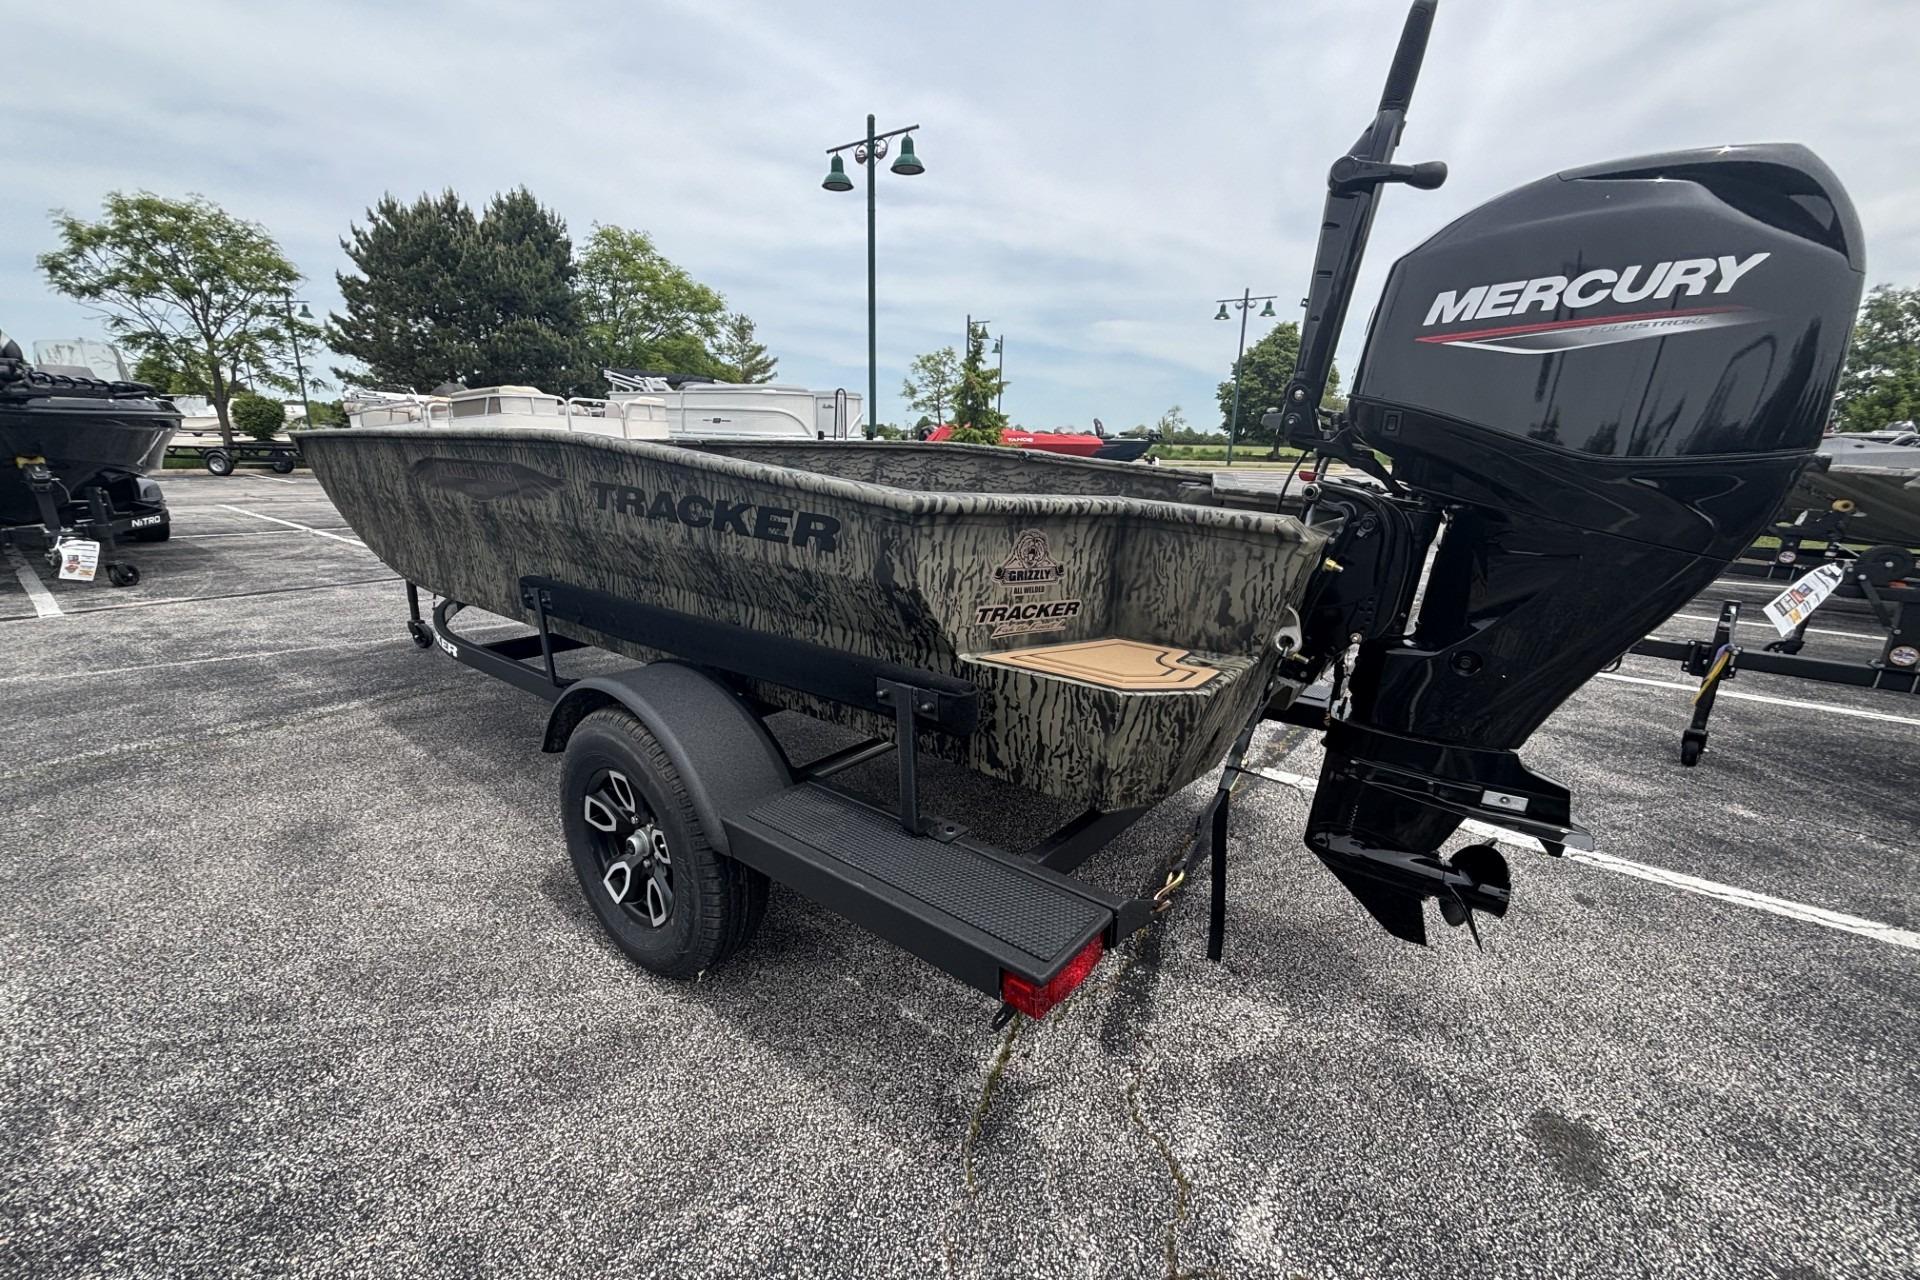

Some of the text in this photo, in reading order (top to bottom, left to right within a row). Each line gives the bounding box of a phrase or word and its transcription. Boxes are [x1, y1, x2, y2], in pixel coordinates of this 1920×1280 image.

[1422, 252, 1771, 326] MERCURY
[1588, 315, 1709, 335] FOURSTROKE
[590, 481, 841, 554] TRACKER
[1008, 569, 1051, 581] GRIZZLY
[978, 601, 1080, 623] TRACKER
